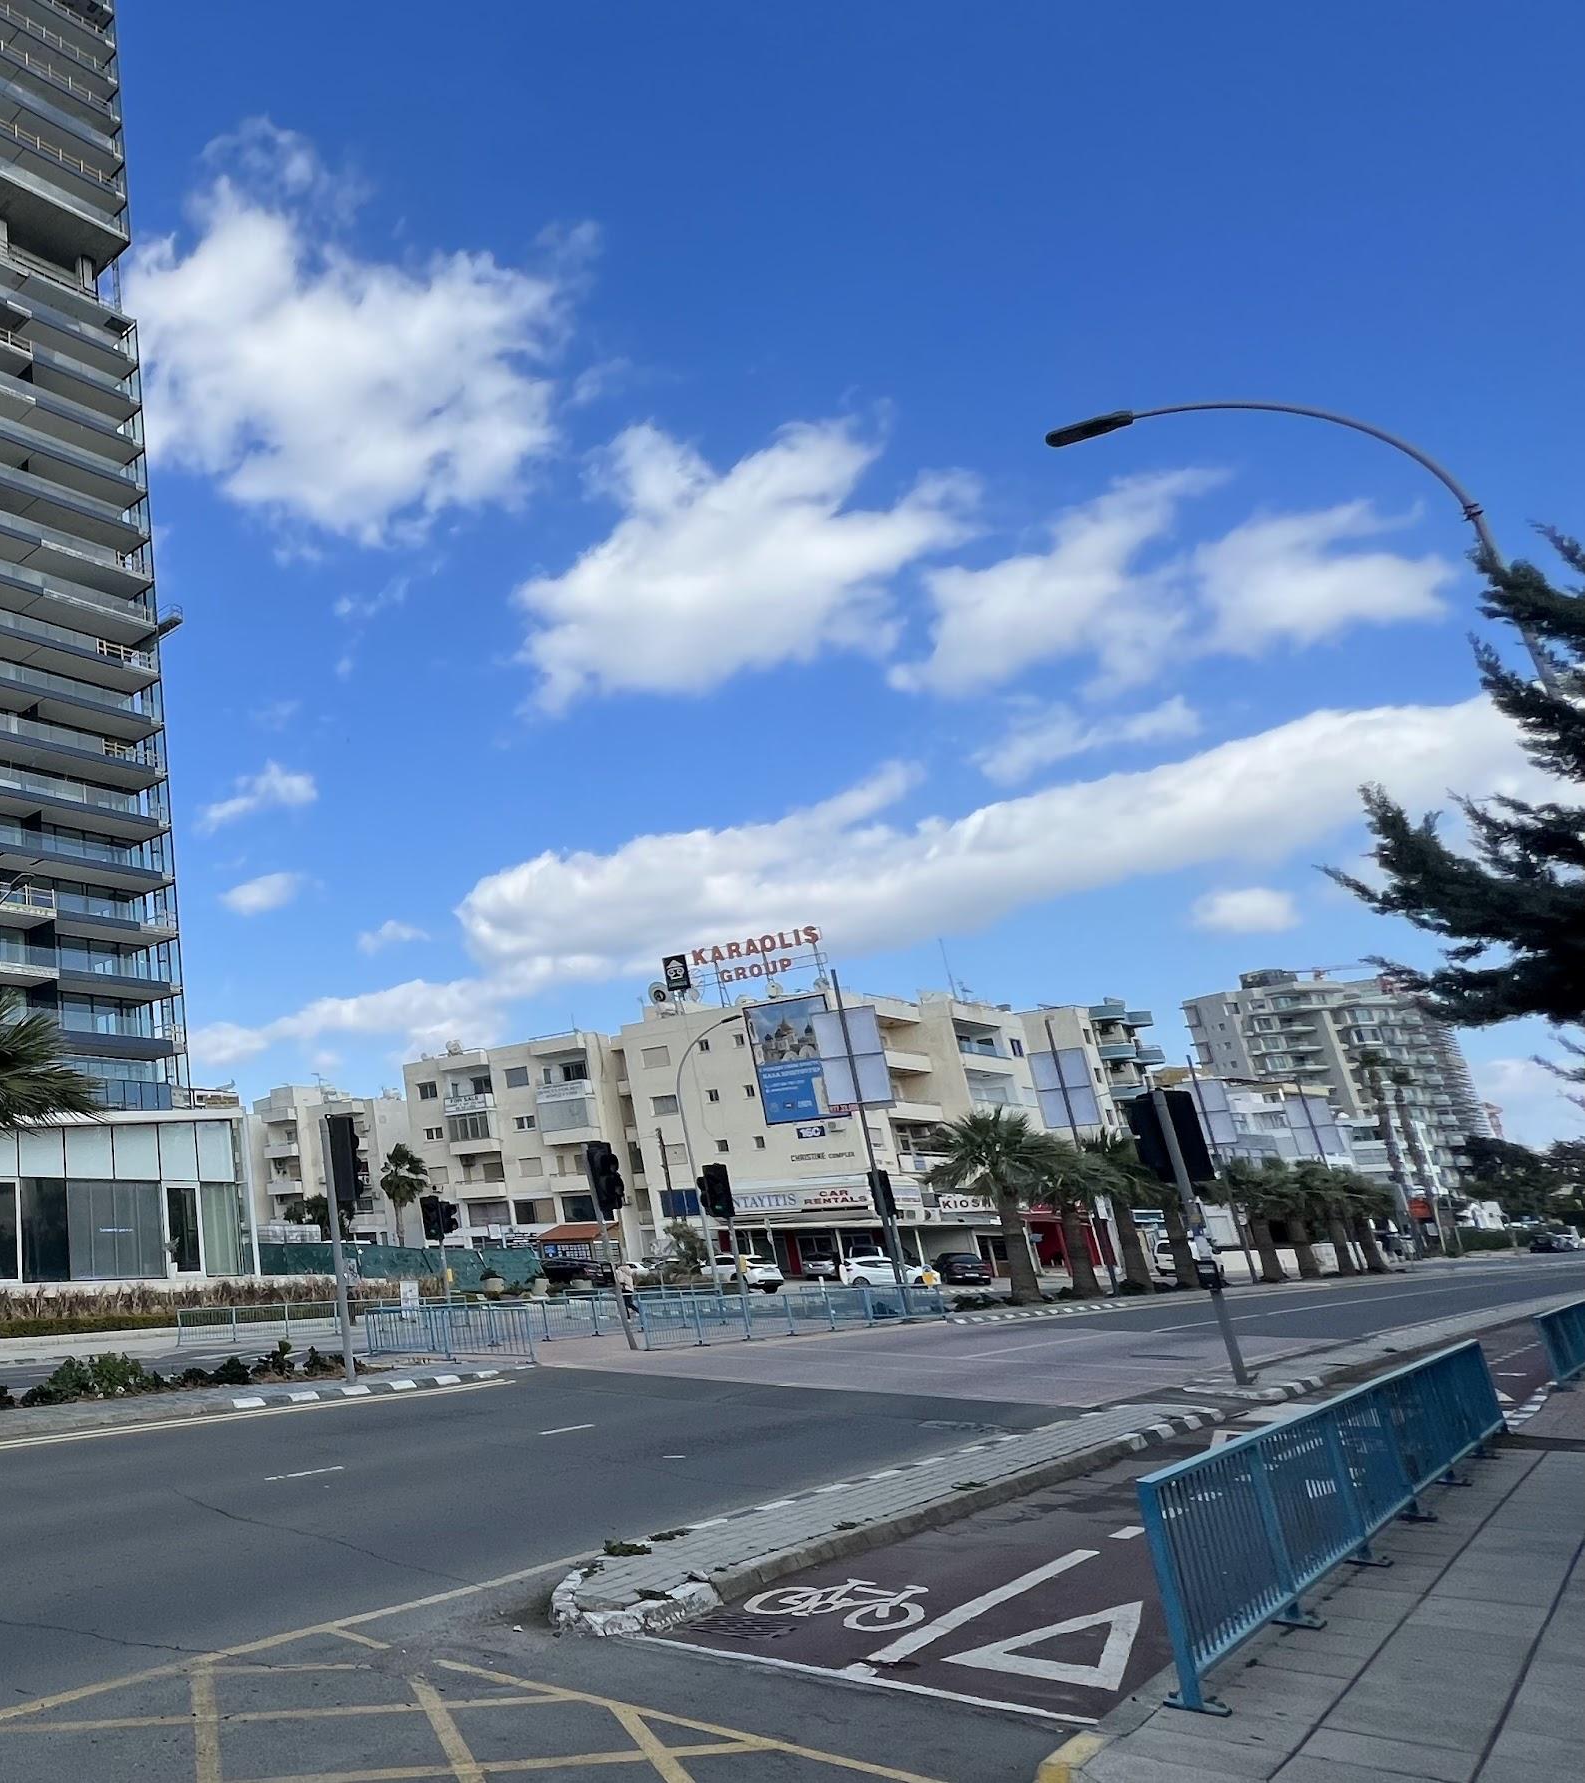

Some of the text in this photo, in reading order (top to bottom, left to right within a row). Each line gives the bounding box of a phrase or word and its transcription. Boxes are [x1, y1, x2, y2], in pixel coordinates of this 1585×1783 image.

[691, 925, 820, 966] KARAOLIS
[720, 957, 792, 983] GROUP
[803, 1195, 868, 1205] RENTALS
[819, 1189, 849, 1197] CAR
